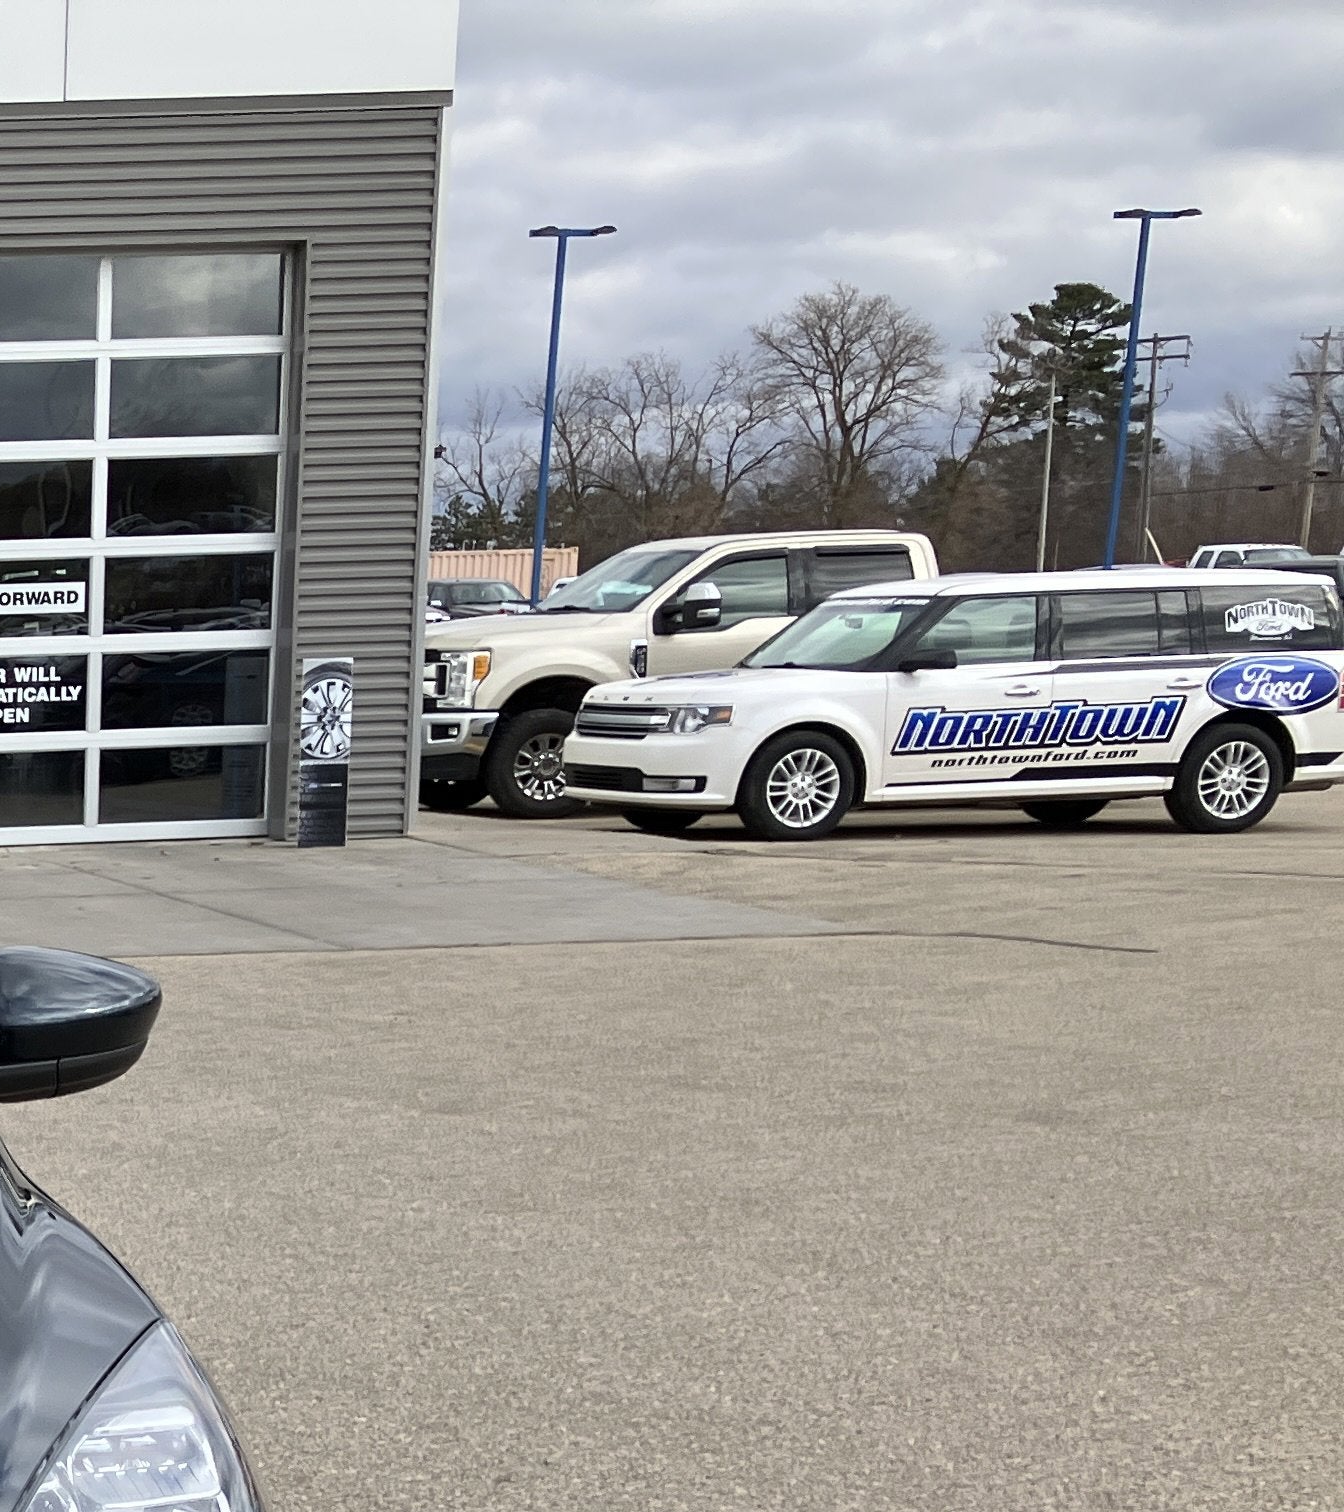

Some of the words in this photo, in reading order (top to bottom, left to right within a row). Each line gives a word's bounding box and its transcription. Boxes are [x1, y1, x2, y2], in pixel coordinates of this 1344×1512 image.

[13, 666, 61, 682] WILL
[1235, 663, 1314, 702] Ford
[893, 699, 1183, 754] NORTHTOWN
[931, 749, 1138, 768] northtownford.com
